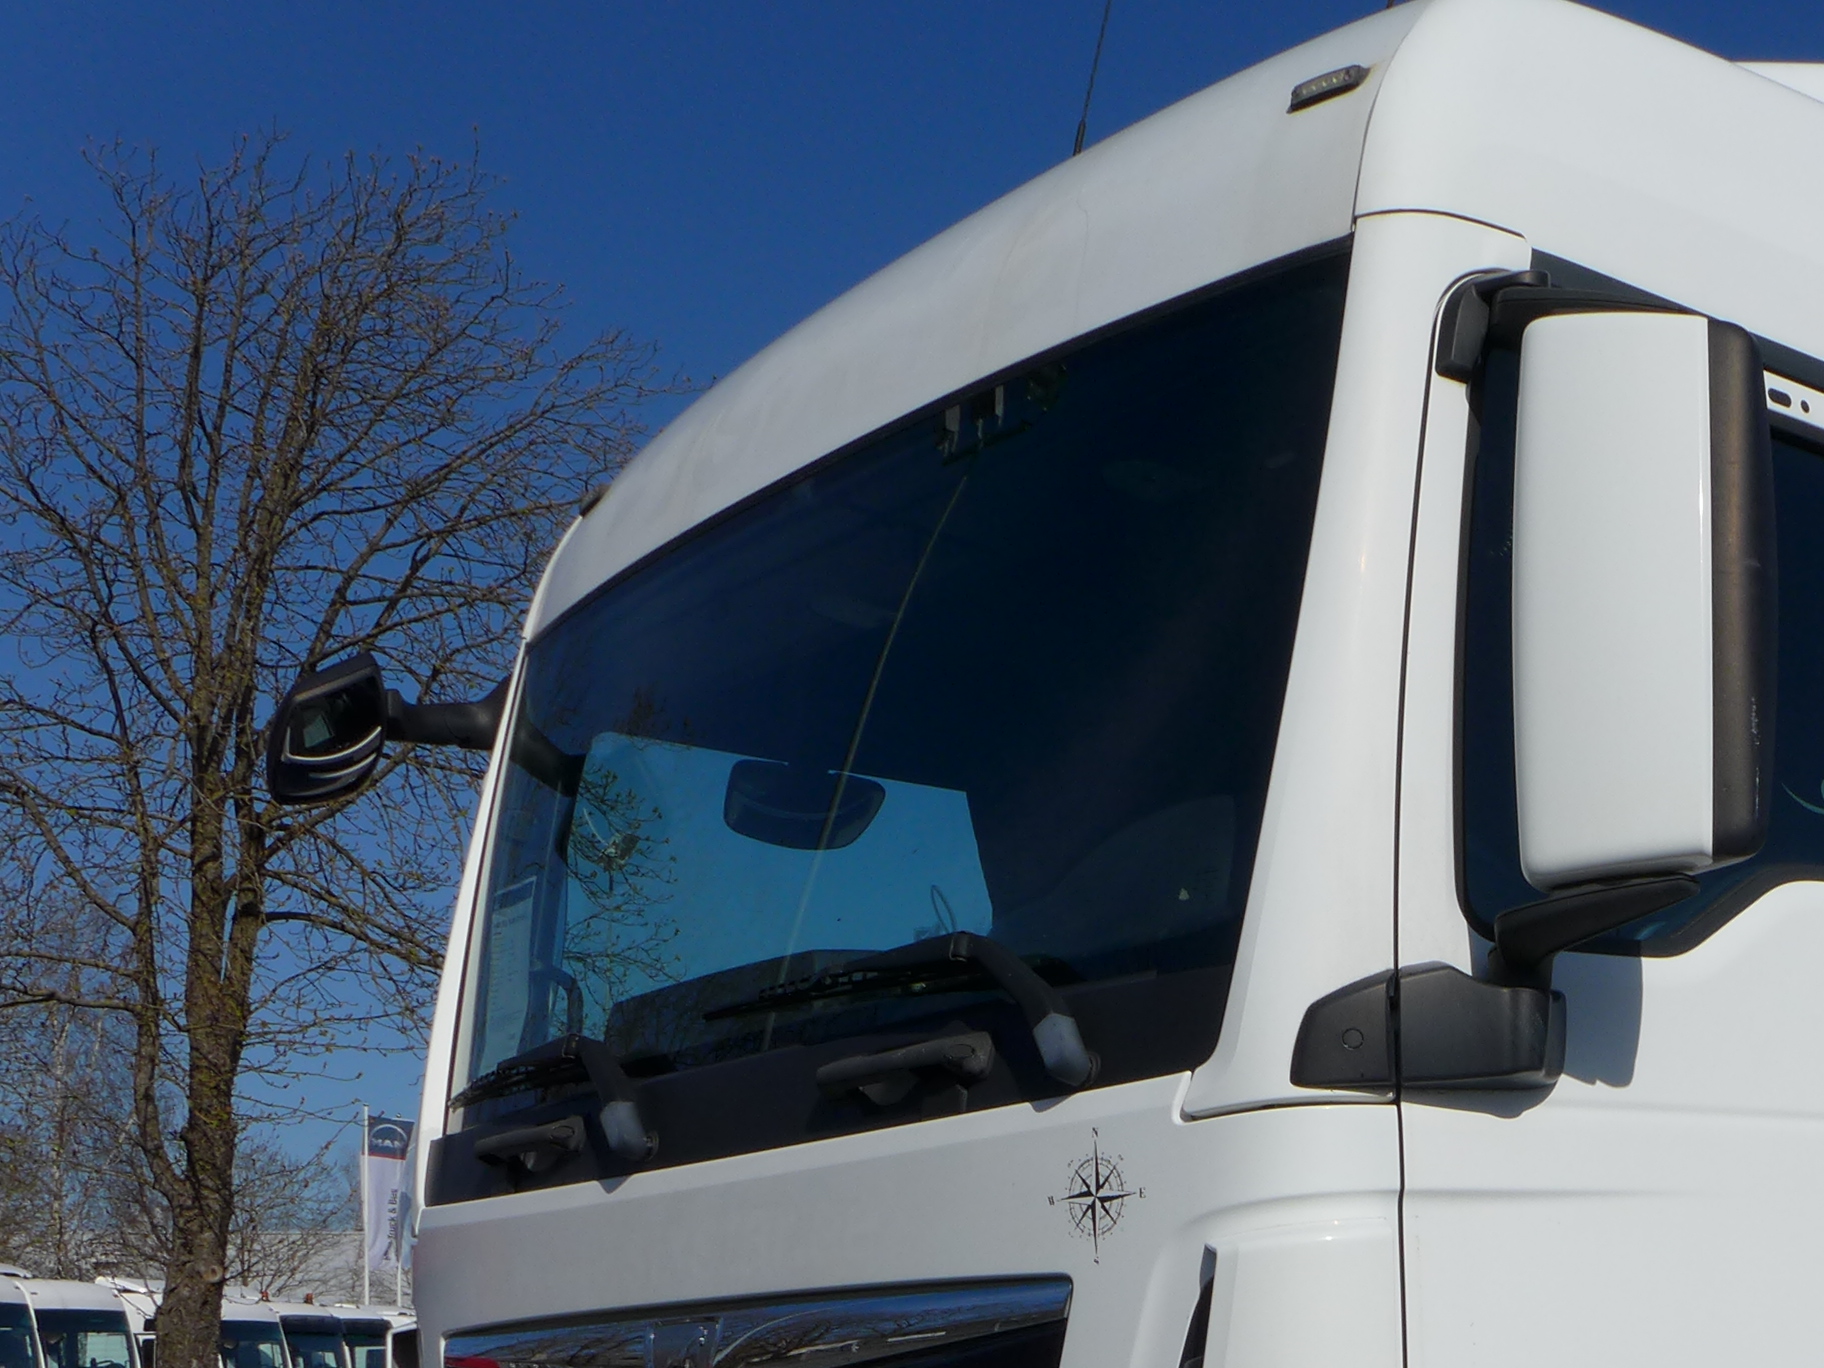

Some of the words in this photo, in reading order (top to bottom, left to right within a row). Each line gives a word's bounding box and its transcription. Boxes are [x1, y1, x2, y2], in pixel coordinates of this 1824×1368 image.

[1091, 1127, 1099, 1138] N
[370, 1137, 405, 1149] MAN
[1139, 1187, 1147, 1198] E
